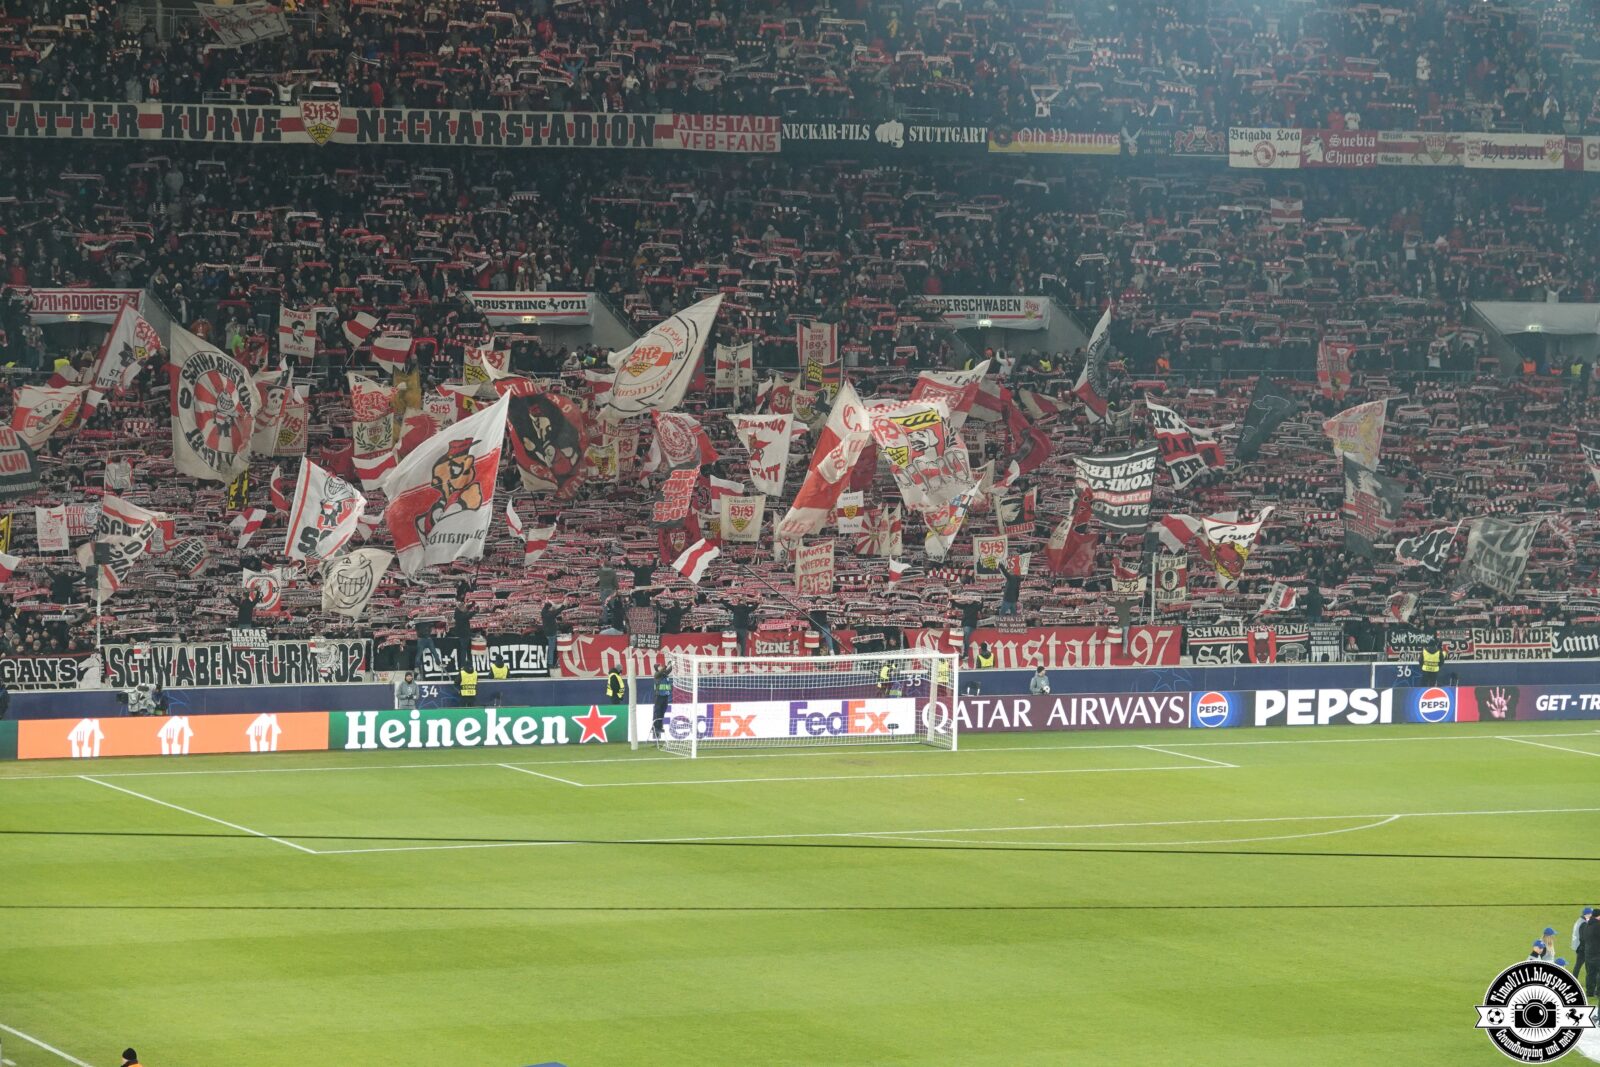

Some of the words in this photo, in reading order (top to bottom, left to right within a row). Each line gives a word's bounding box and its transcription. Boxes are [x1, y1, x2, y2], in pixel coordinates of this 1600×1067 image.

[0, 102, 138, 137] TATTER
[162, 104, 281, 142] KURVE
[357, 109, 655, 147] NECKARSTADION
[677, 114, 779, 132] ALBSTADT
[679, 132, 777, 152] VFB-FANS
[782, 123, 870, 141] NECKAR-FILS
[908, 126, 987, 144] STUTTGART
[1017, 127, 1048, 146] Old
[1049, 127, 1120, 147] Warriors
[1329, 134, 1375, 146] Suebia
[561, 299, 587, 310] 0711
[730, 505, 754, 517] VfB
[231, 629, 267, 637] ULTRAS
[755, 640, 788, 655] SZENE
[1130, 629, 1173, 666] 97
[1475, 648, 1551, 660] STUTTGART
[0, 658, 78, 683] GANS
[109, 645, 319, 688] SCHWABENSTURM
[335, 644, 363, 683] 02
[1397, 666, 1412, 677] 36
[906, 674, 922, 686] 35
[421, 685, 439, 697] 34
[1199, 704, 1226, 714] PEPSI
[1255, 688, 1393, 726] PEPSI
[1420, 700, 1448, 709] PEPSI
[789, 700, 891, 736] FedEx
[922, 697, 1032, 733] QATAR
[1046, 695, 1185, 726] AIRWAYS
[345, 708, 569, 750] Heineken
